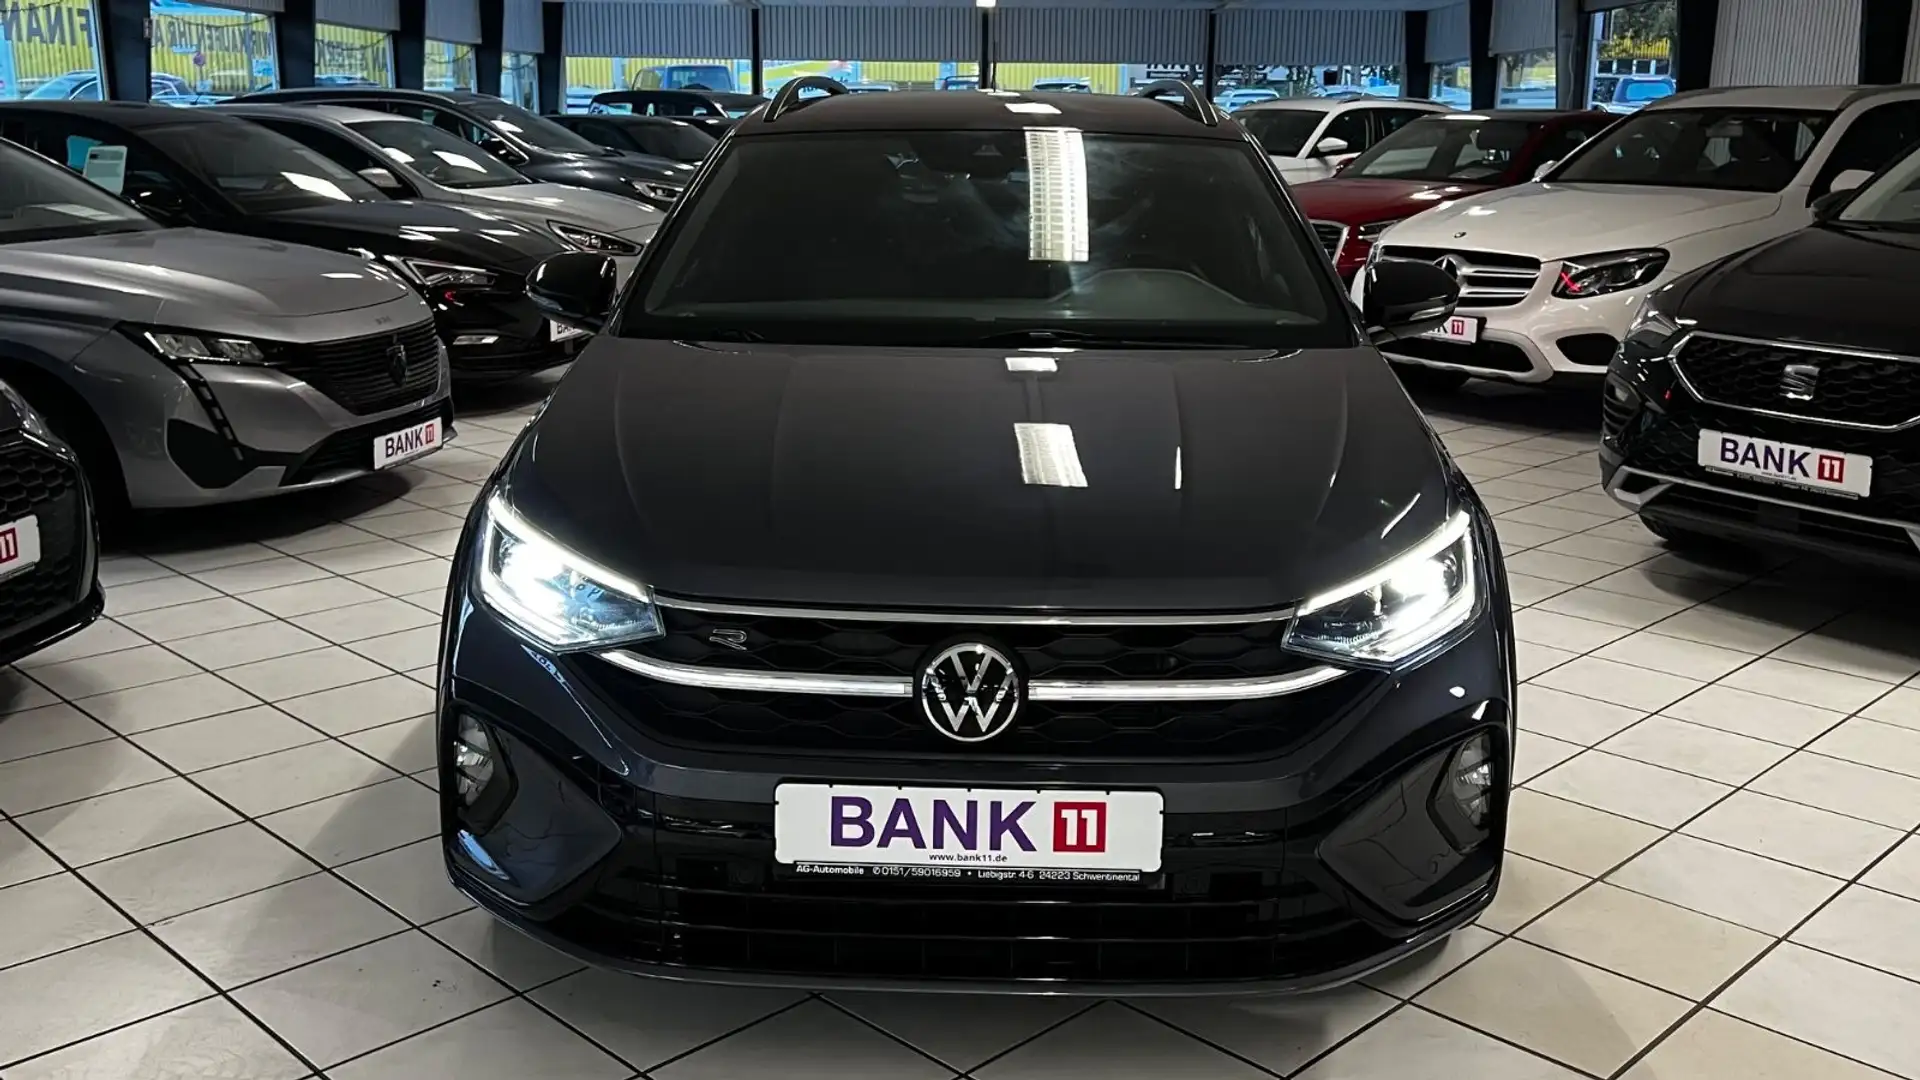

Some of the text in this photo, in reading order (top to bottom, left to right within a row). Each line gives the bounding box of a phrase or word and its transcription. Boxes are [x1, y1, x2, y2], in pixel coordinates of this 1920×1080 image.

[1453, 321, 1463, 334] 11
[385, 425, 434, 458] BANK 11
[1720, 437, 1841, 480] BANK 11
[831, 796, 1099, 852] BANK 11
[929, 853, 1008, 863] www.bank11.de
[796, 864, 864, 875] AG-Automobile
[1039, 872, 1070, 880] 24223
[1072, 872, 1140, 882] Schwentinental
